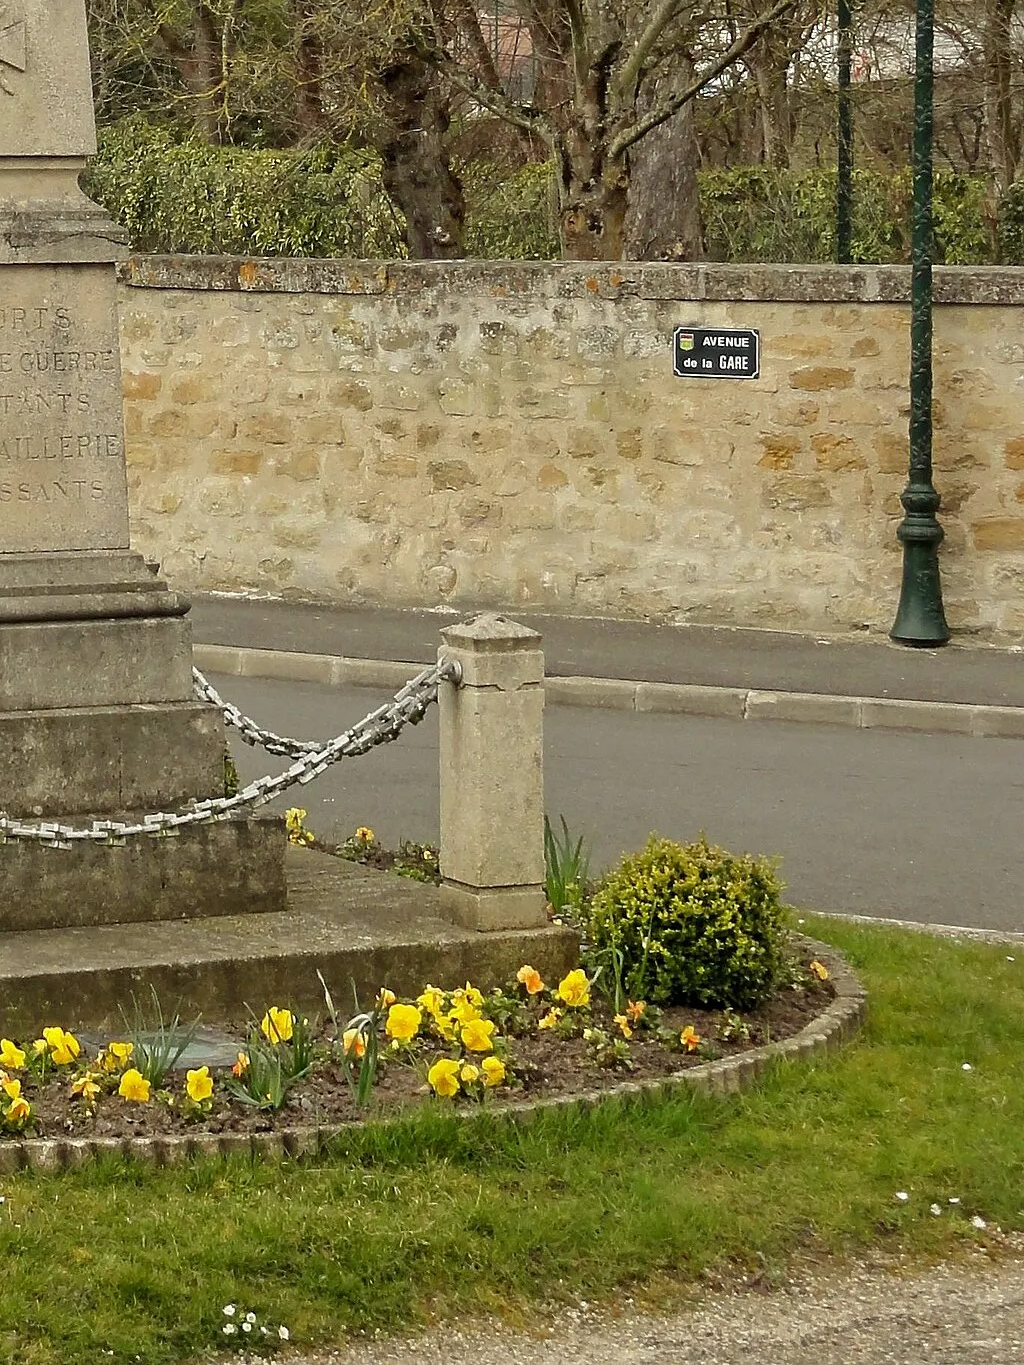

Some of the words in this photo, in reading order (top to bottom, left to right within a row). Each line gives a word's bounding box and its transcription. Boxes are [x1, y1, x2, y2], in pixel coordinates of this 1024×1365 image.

[703, 337, 749, 347] AVENUE
[18, 349, 115, 374] GUERRE
[683, 358, 697, 367] de
[702, 358, 713, 368] la
[719, 355, 748, 369] GARE
